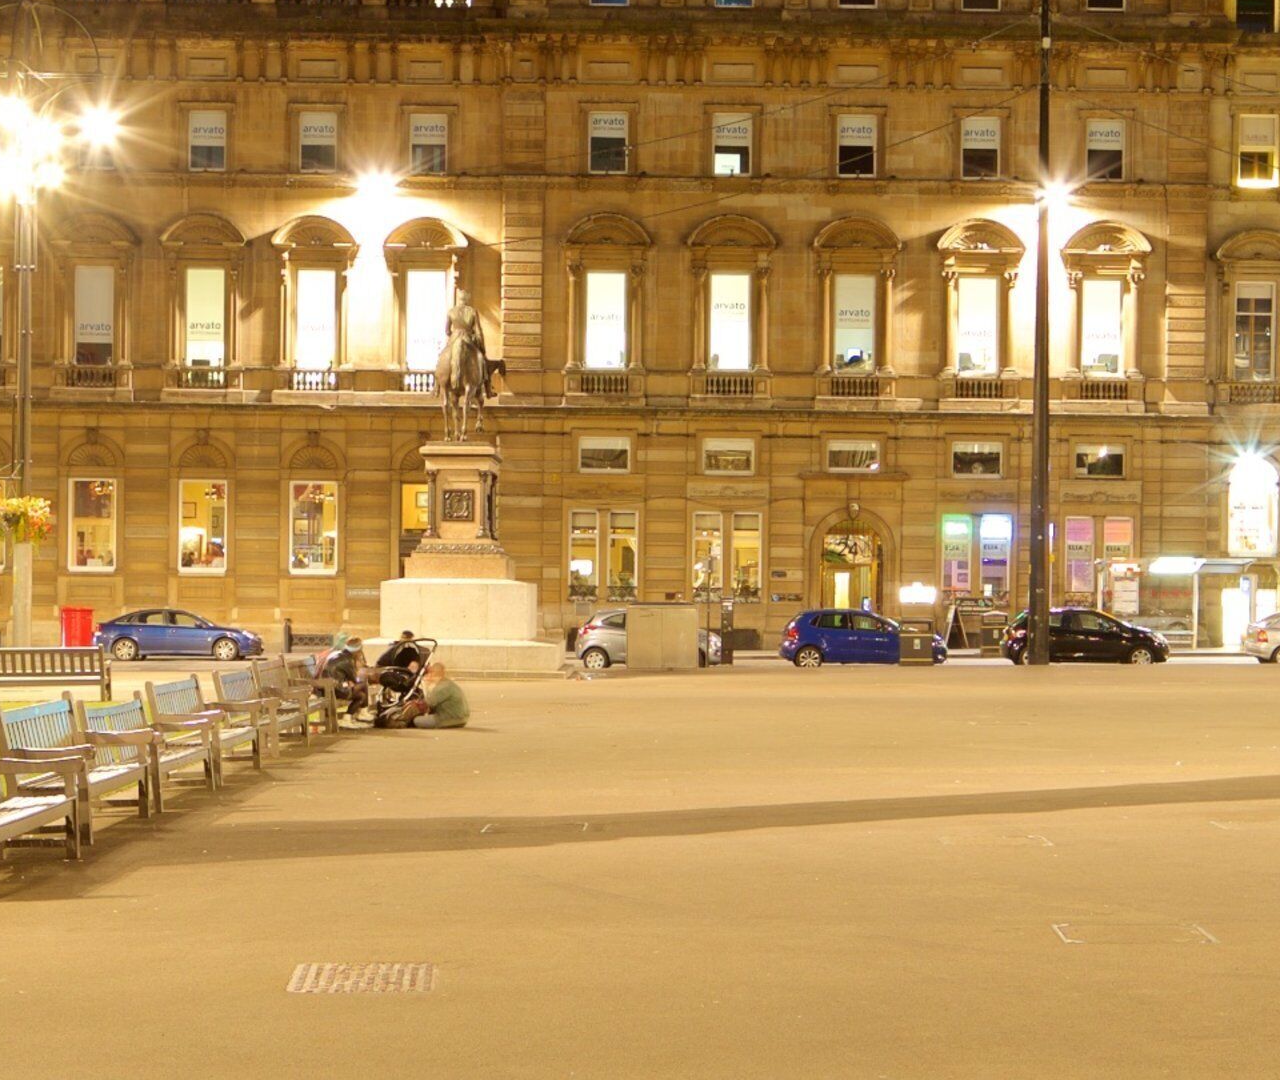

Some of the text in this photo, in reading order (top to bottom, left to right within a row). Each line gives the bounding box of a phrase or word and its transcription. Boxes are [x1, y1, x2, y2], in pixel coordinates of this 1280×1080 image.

[592, 117, 625, 126] arvato
[192, 126, 225, 135] arvato
[303, 125, 335, 134] arvato
[413, 124, 446, 133] arvato
[716, 126, 748, 135] arvato
[840, 126, 873, 134] arvato
[964, 129, 996, 137] arvato
[1088, 130, 1121, 138] arvato
[714, 302, 746, 311] arvato
[838, 309, 871, 318] arvato
[80, 323, 111, 332] arvato
[189, 321, 221, 330] arvato
